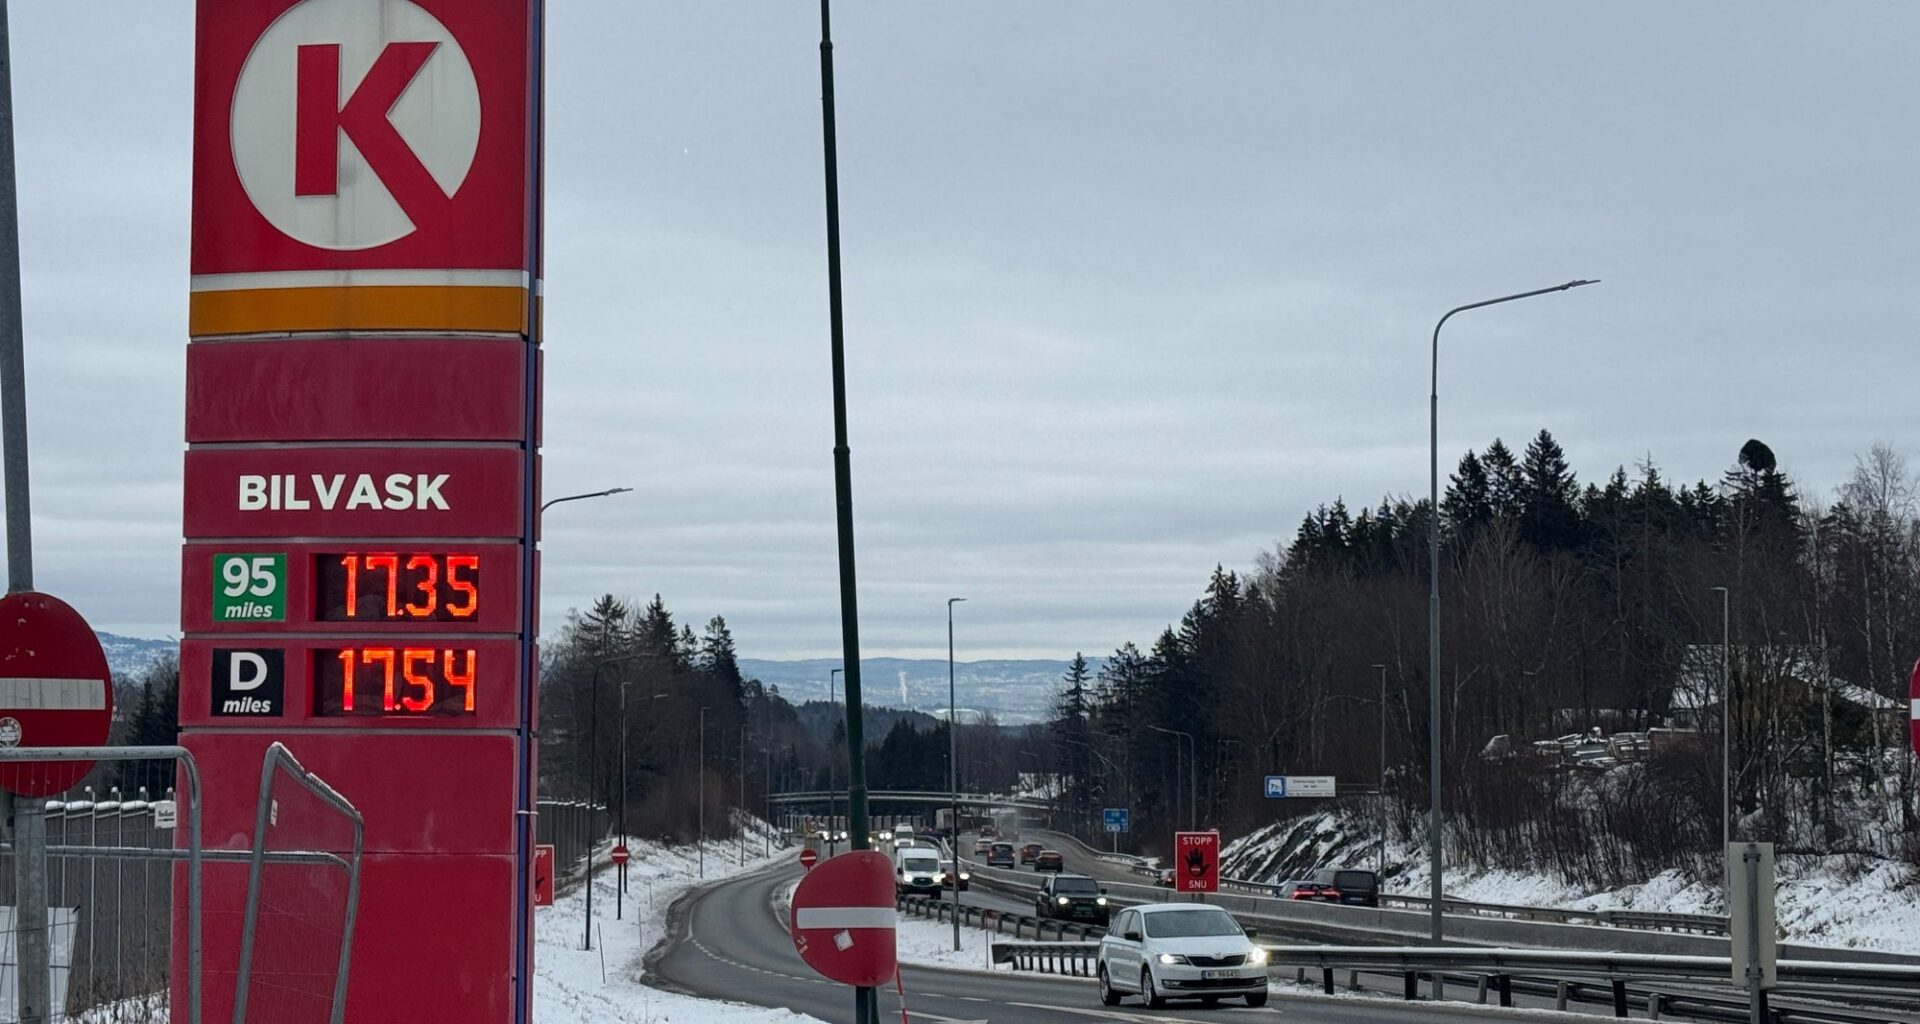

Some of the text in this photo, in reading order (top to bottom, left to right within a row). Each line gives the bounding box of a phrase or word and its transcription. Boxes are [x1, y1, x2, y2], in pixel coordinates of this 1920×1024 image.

[239, 473, 451, 511] BILVASK
[222, 557, 277, 597] 95
[341, 555, 479, 617] 17.35
[225, 602, 273, 619] miles
[230, 652, 268, 691] D
[338, 649, 476, 711] 17.54
[223, 697, 271, 713] miles
[1182, 836, 1212, 845] STOPP
[1188, 880, 1207, 889] SNU
